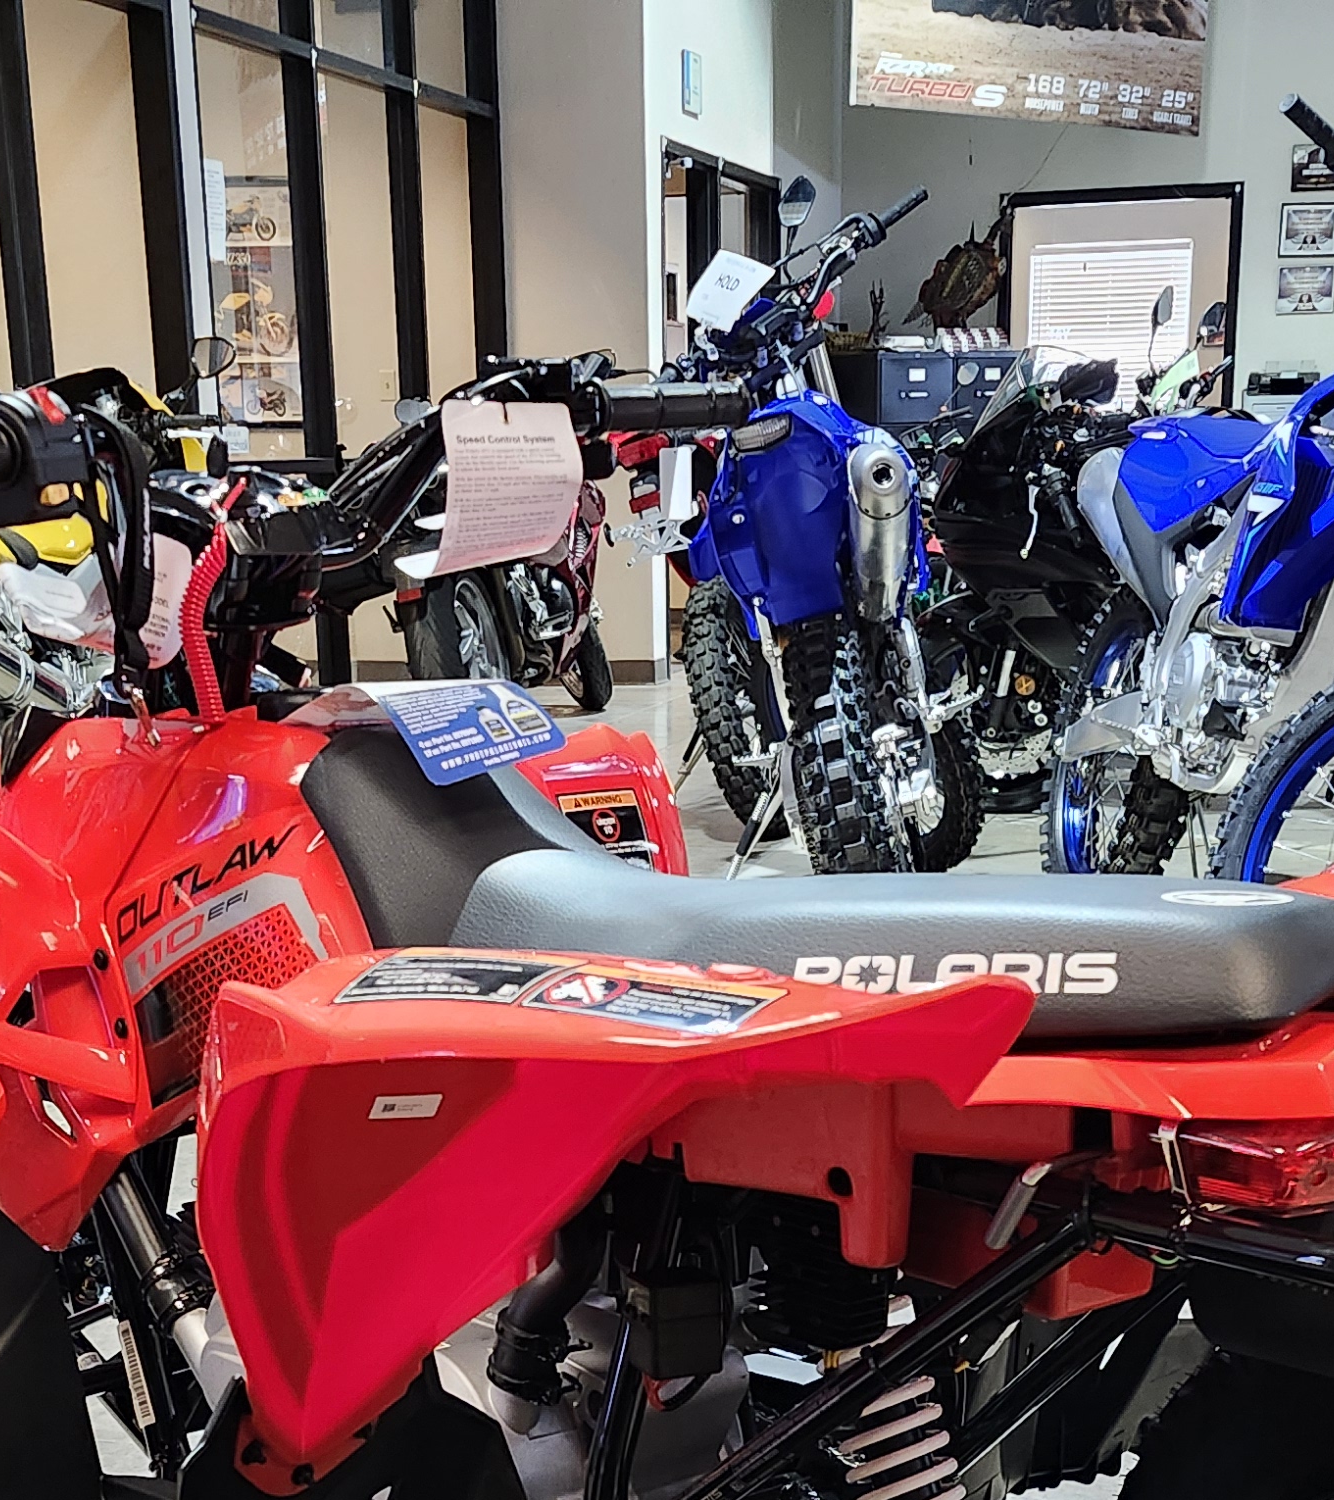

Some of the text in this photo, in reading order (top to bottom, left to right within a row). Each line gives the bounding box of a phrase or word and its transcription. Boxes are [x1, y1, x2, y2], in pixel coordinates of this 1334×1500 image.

[868, 75, 1008, 108] TURBO S
[1027, 73, 1065, 95] 168
[1078, 79, 1109, 99] 72"
[1161, 89, 1194, 109] 25"
[714, 272, 741, 292] HOLD
[456, 435, 556, 445] Speed Control System
[582, 794, 623, 806] WARNING
[117, 823, 301, 946] OUTLAW
[136, 890, 249, 978] 110 EFI
[794, 952, 1119, 994] POLARIS
